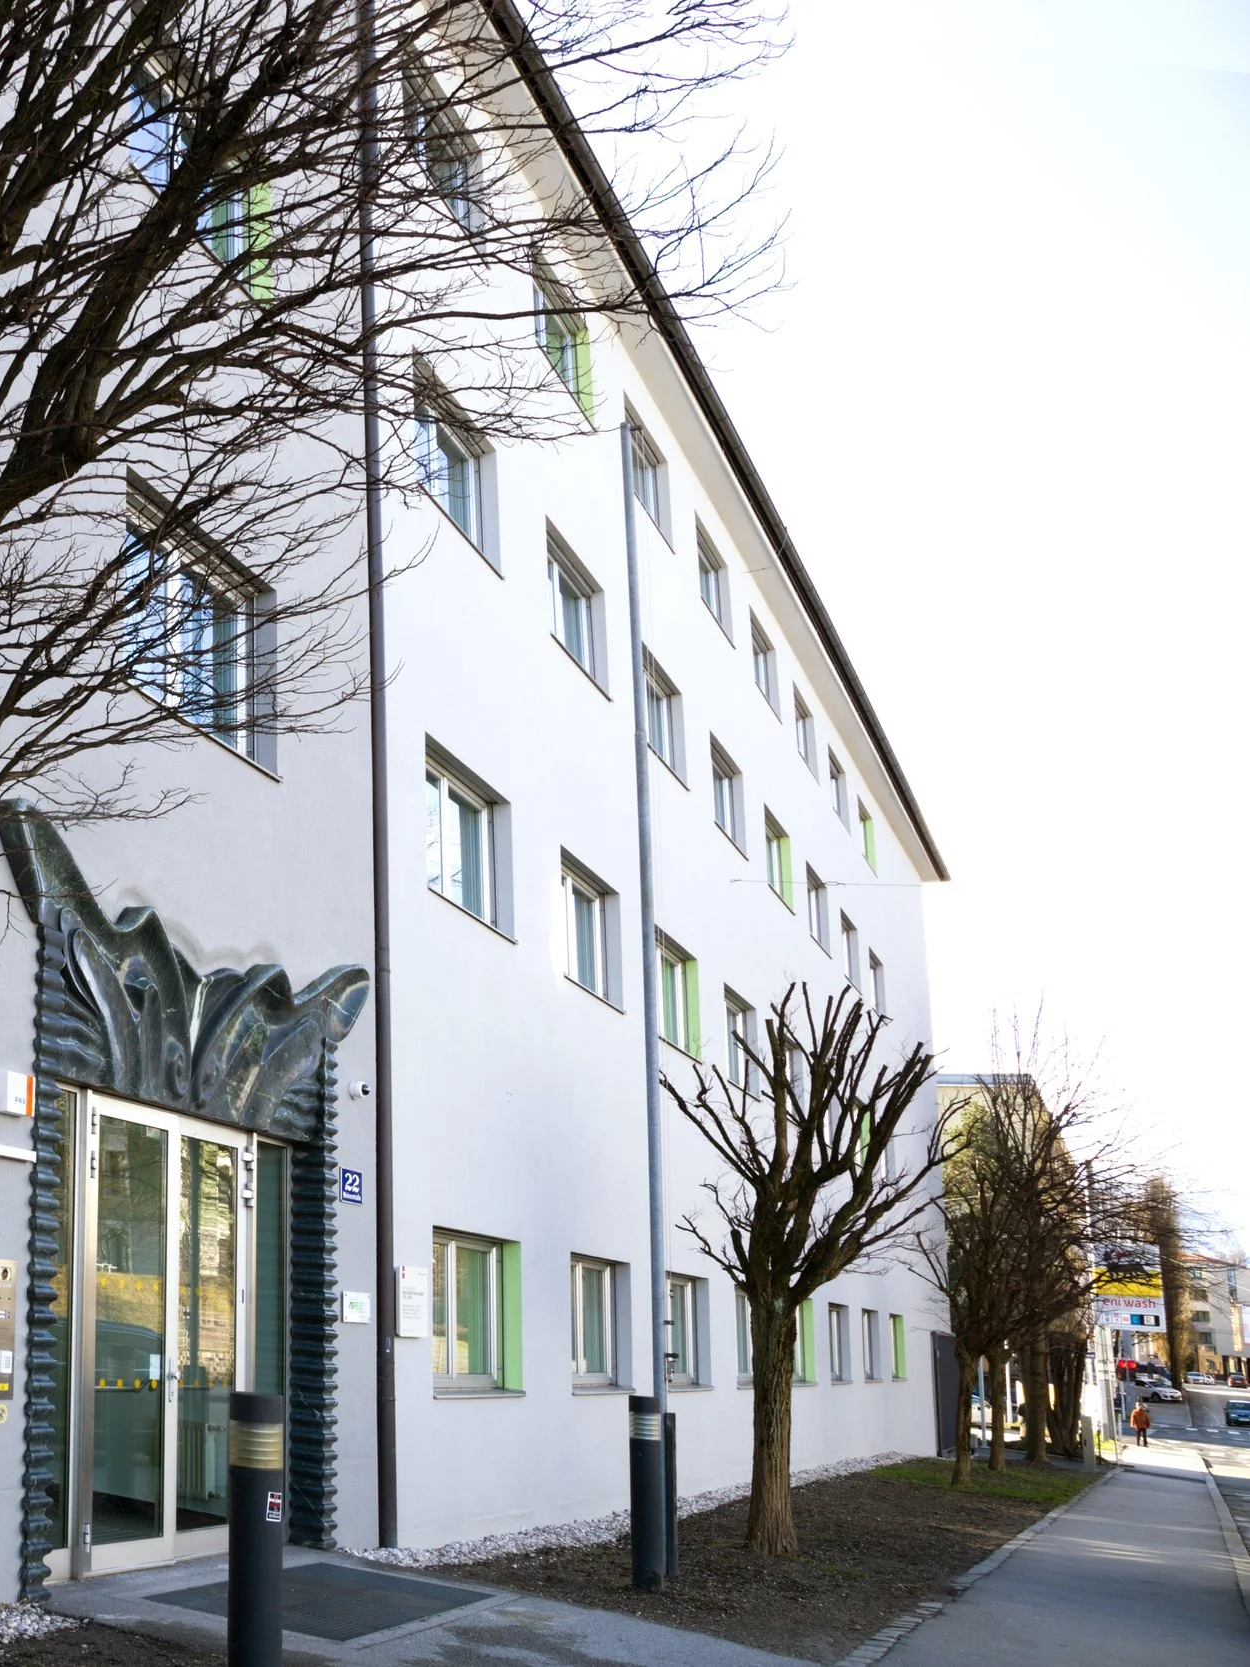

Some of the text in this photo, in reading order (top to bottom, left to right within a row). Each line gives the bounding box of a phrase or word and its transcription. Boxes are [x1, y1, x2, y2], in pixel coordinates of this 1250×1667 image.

[14, 1096, 27, 1105] PKE
[344, 1172, 360, 1193] 22
[1103, 1297, 1156, 1309] eni wash
